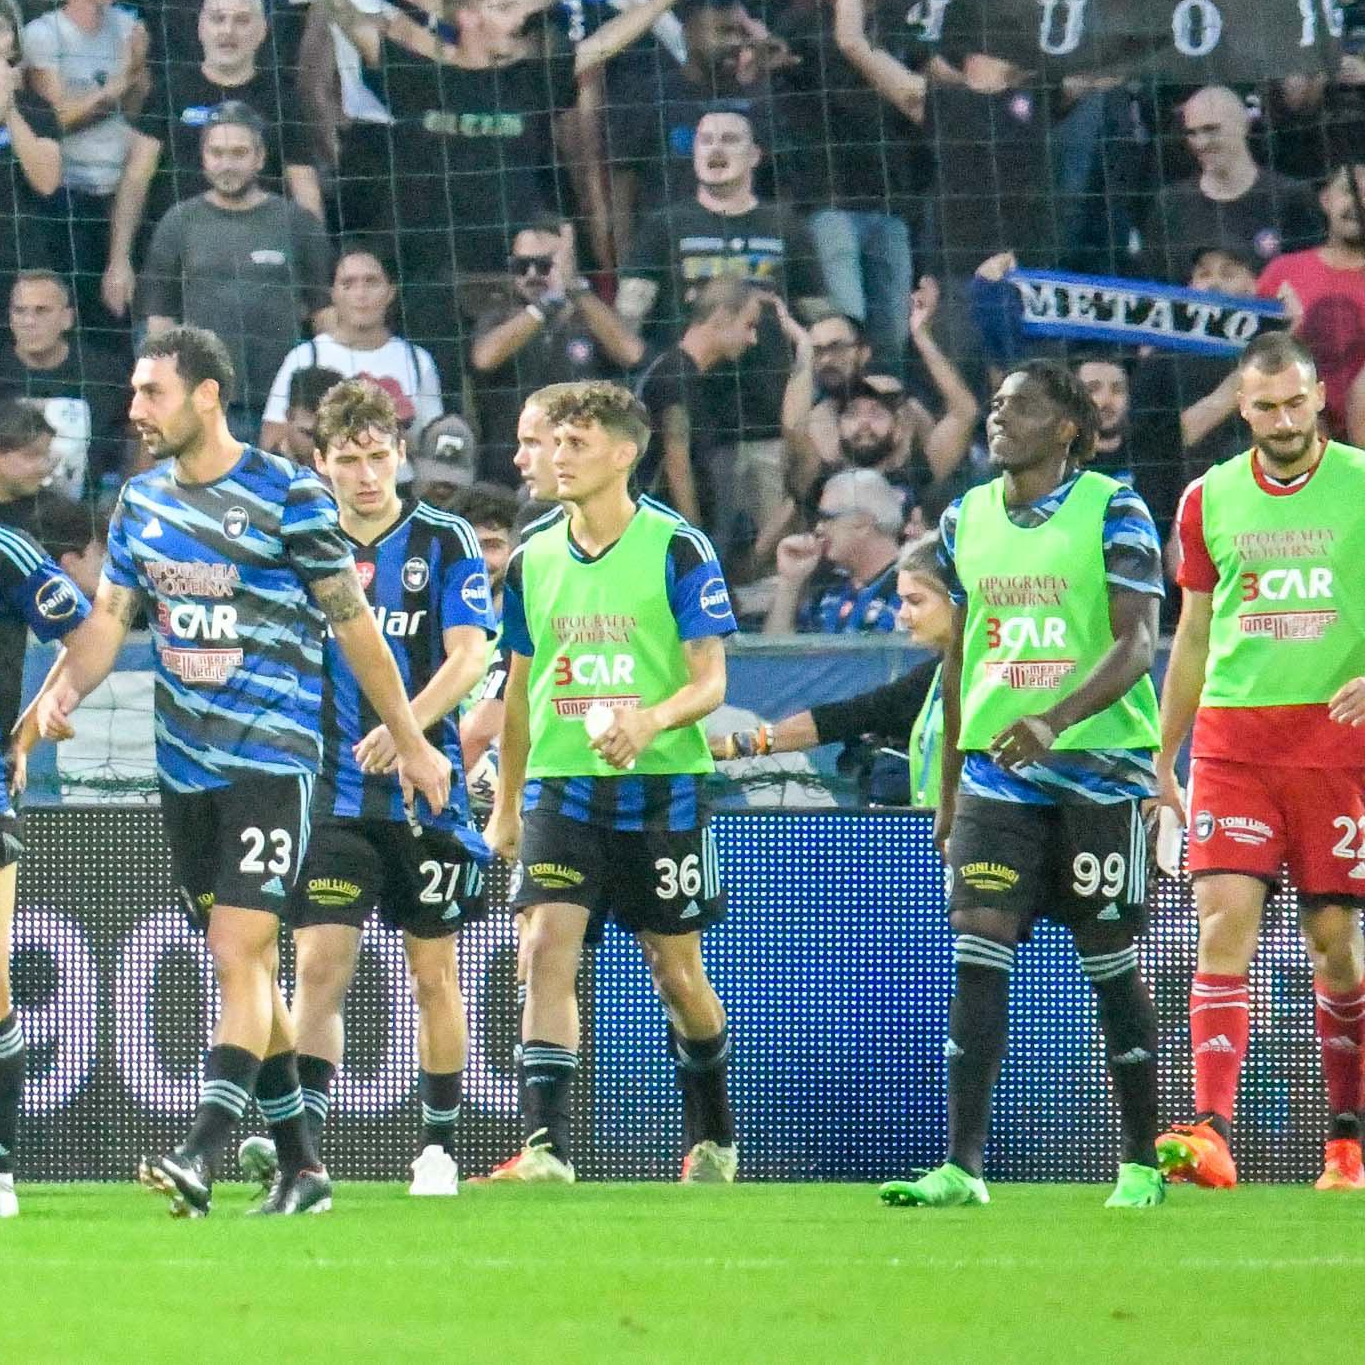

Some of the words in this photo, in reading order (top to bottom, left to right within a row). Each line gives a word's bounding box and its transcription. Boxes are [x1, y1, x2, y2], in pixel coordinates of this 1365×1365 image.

[1019, 279, 1259, 341] METATO
[1241, 566, 1335, 603] 3CAR
[986, 615, 1067, 650] 3CAR
[554, 653, 636, 687] 3CAR
[240, 826, 292, 875] 23
[419, 859, 456, 904] 27
[654, 853, 703, 900] 36
[1072, 851, 1126, 899] 99
